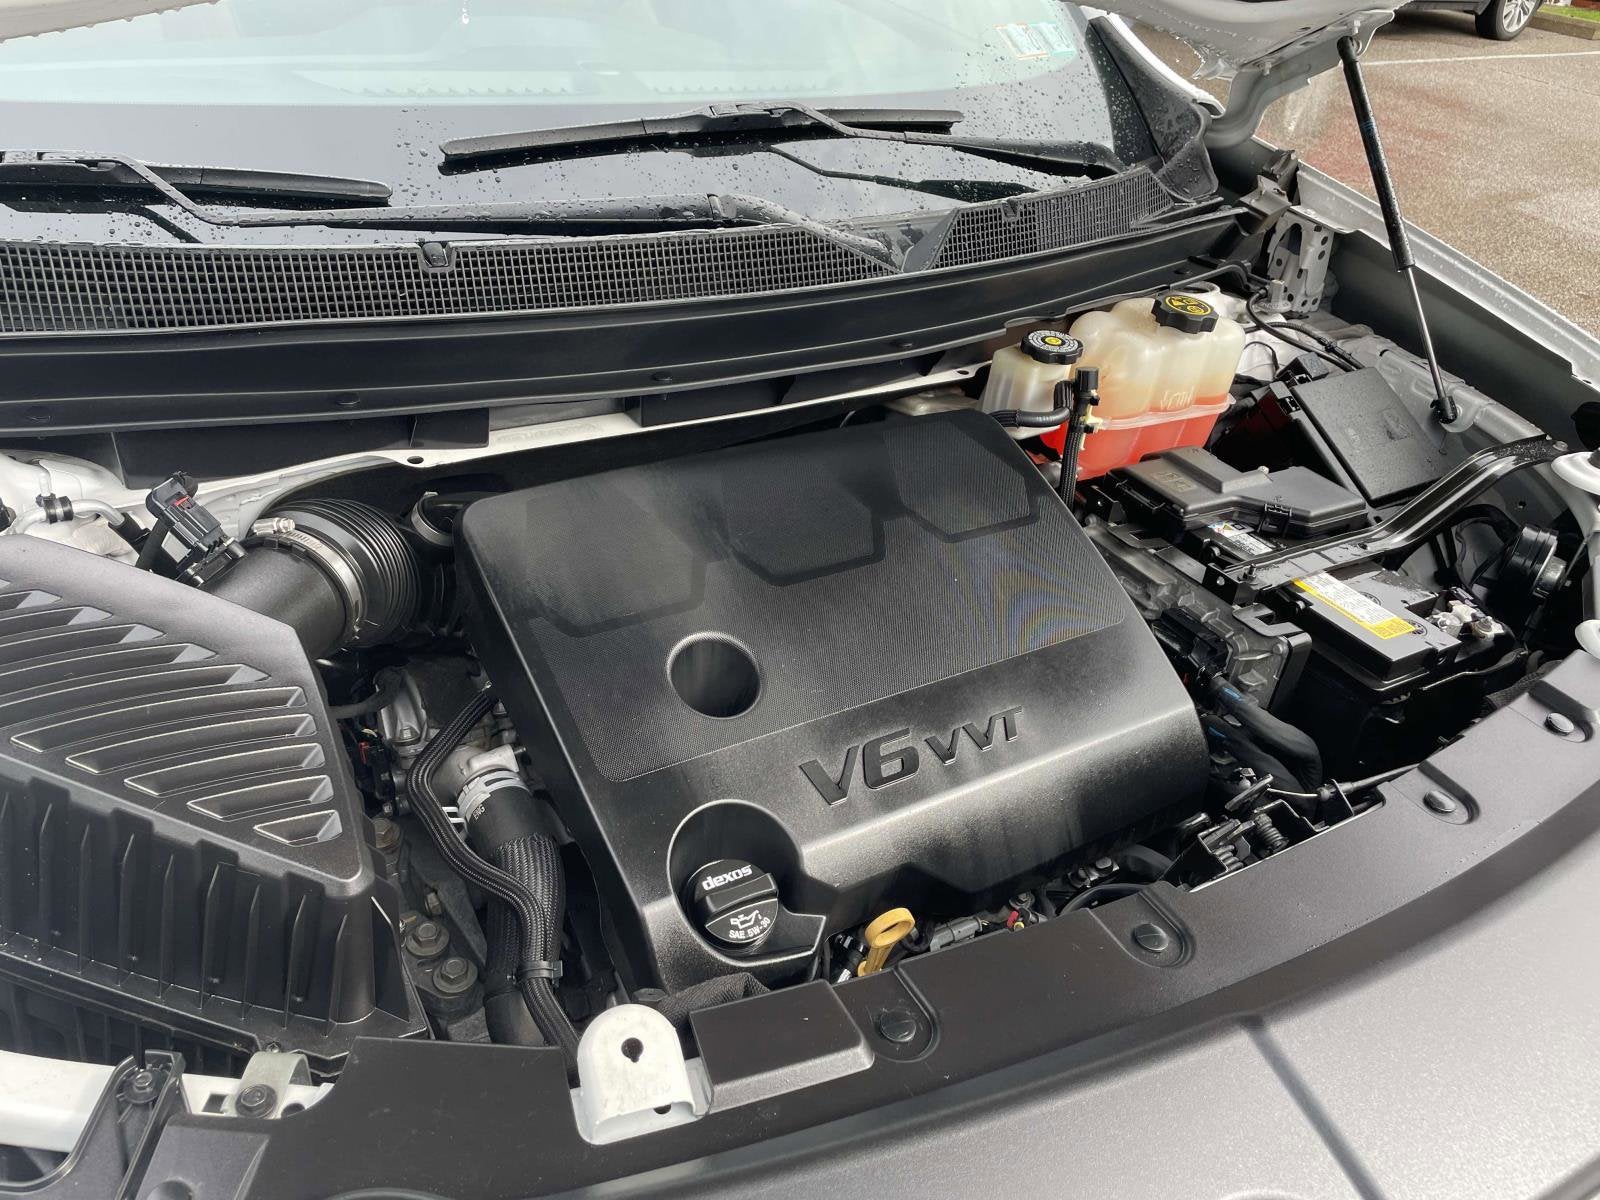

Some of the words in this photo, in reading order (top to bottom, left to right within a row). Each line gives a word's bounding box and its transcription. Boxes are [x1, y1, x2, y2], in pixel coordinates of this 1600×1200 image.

[799, 727, 920, 806] V6
[924, 705, 1023, 765] VVT
[472, 803, 486, 820] ENG
[702, 864, 753, 891] dexos
[728, 929, 746, 939] SAE
[747, 916, 771, 937] 5W-30
